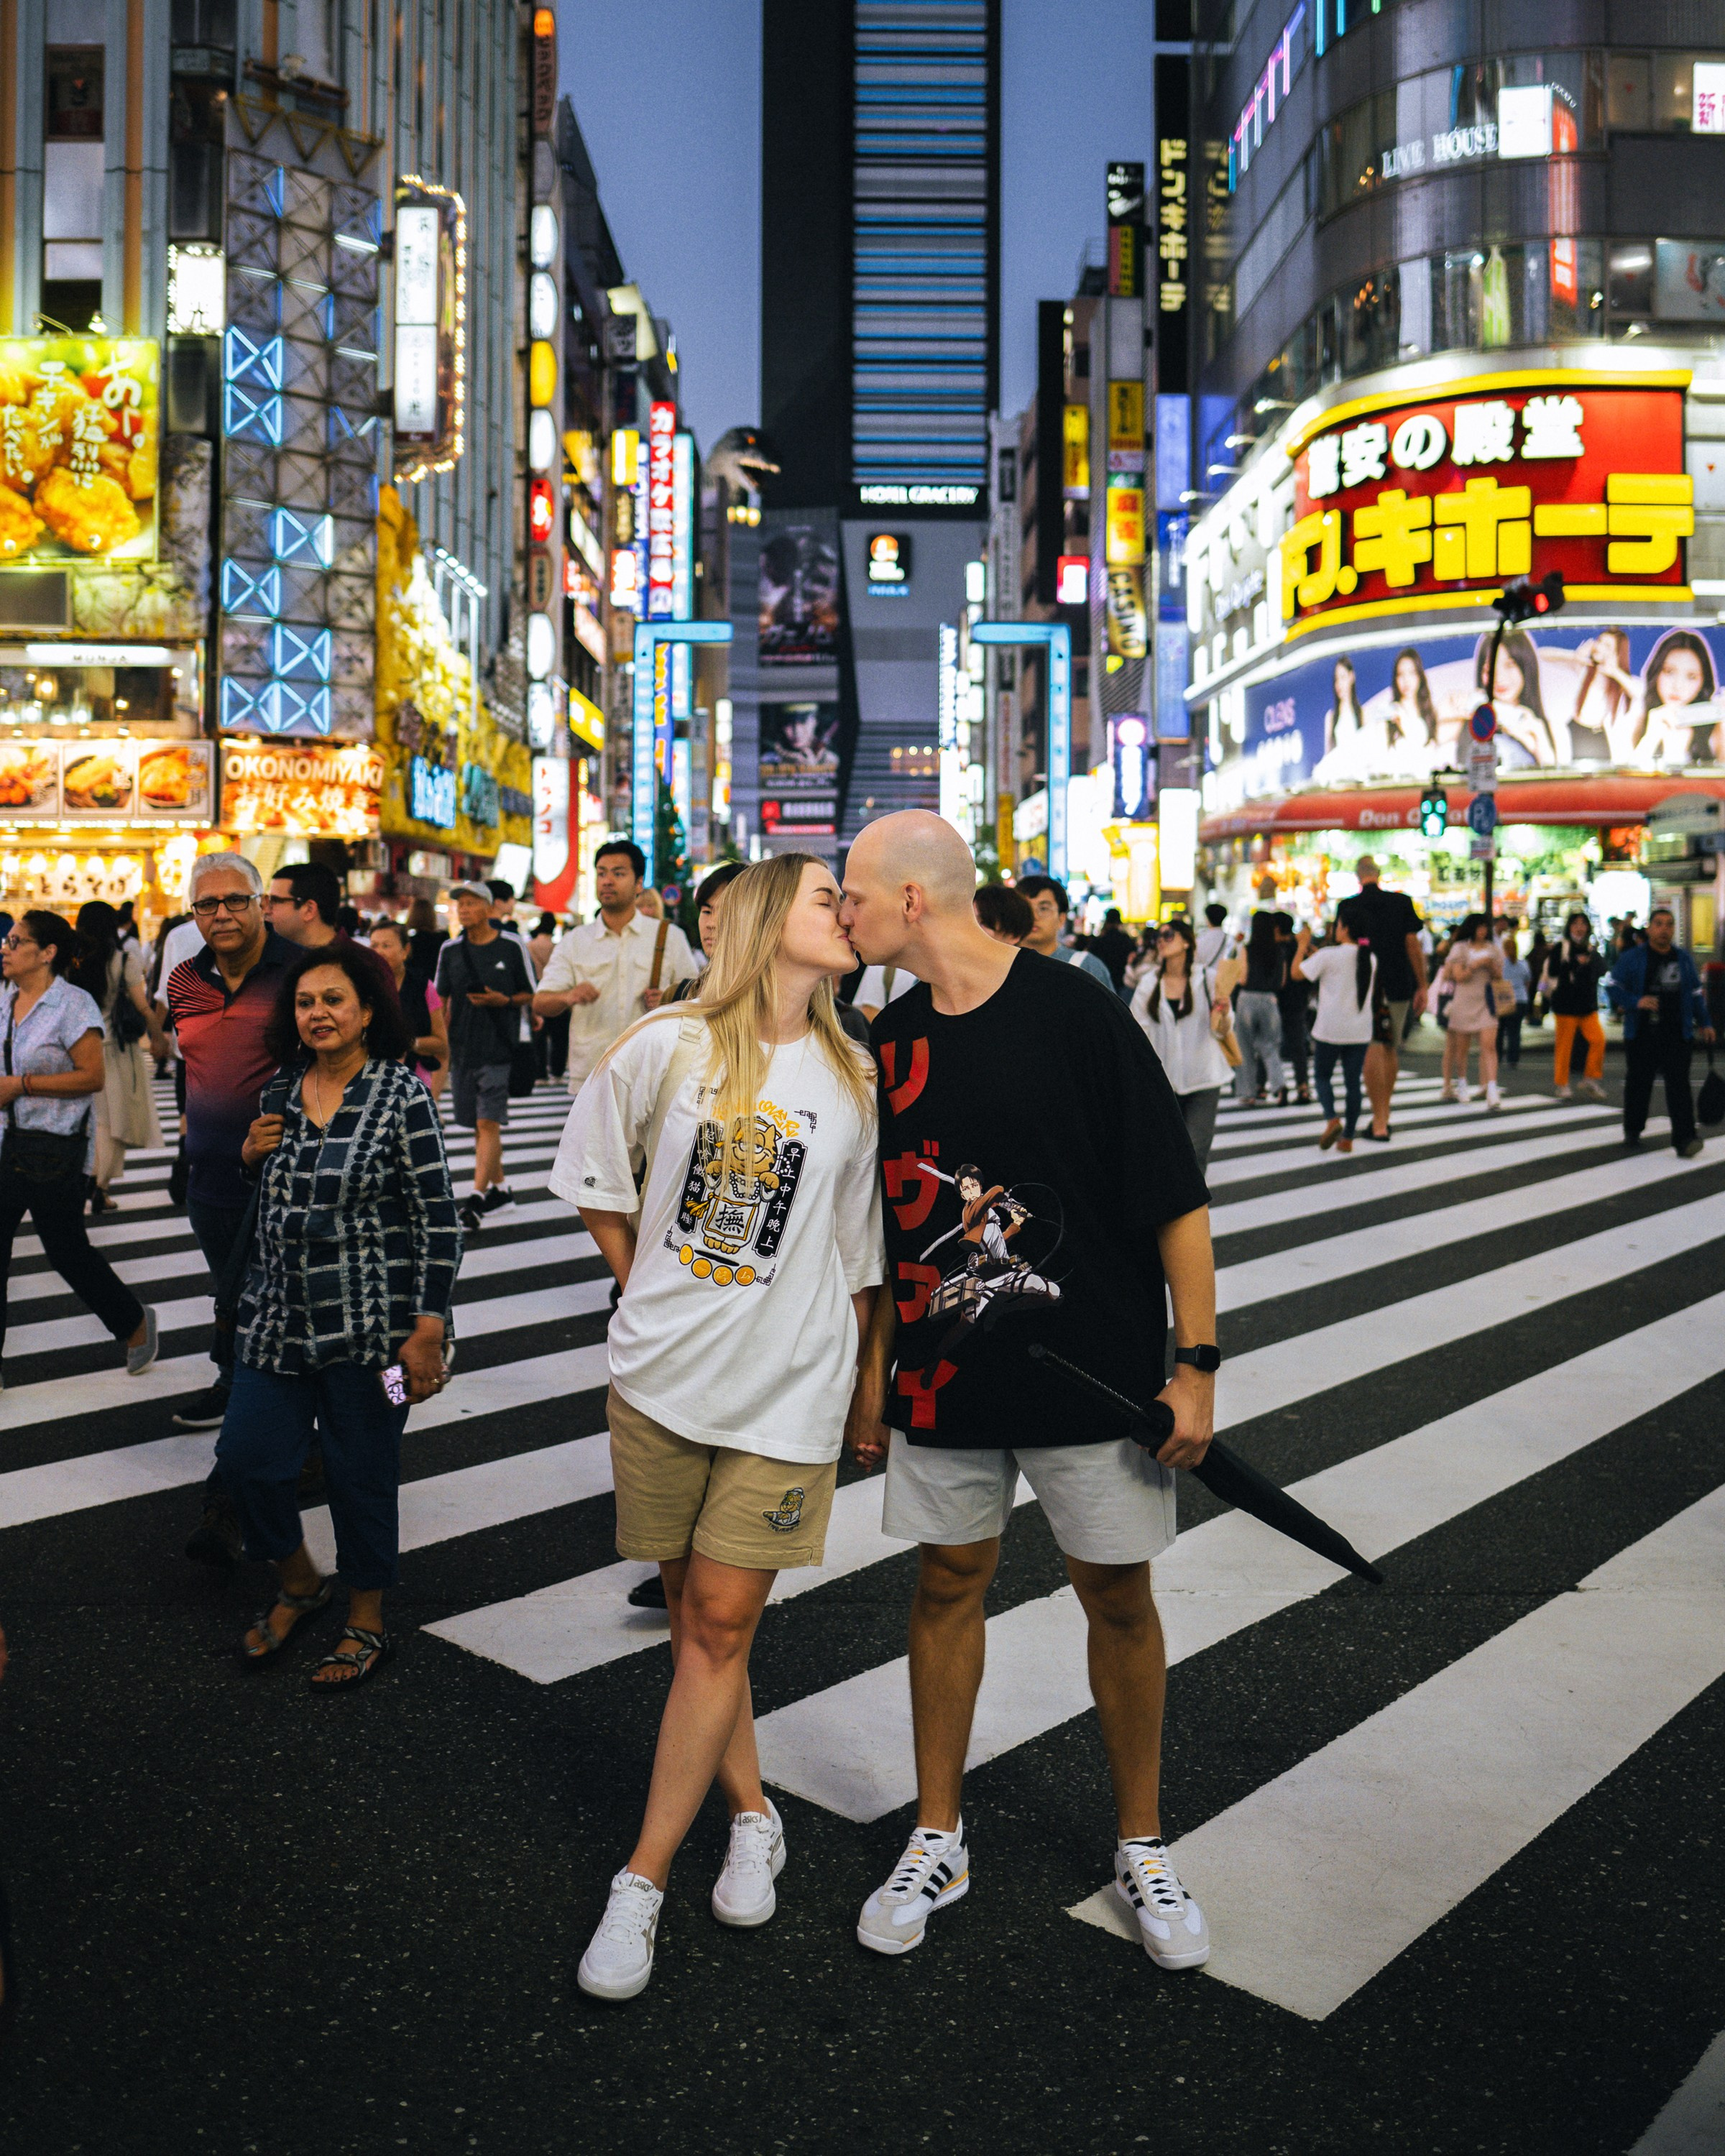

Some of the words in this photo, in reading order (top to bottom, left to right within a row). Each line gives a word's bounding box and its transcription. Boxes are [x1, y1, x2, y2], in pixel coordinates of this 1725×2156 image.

[1381, 139, 1425, 179] LIVE
[1432, 123, 1499, 162] HOUSE
[1307, 395, 1585, 499] 驚安の殿堂
[1109, 571, 1141, 650] CASINO
[224, 755, 384, 789] OKONOMIYAKI
[1359, 808, 1400, 829] Don
[715, 1204, 745, 1235] 撫
[880, 1036, 958, 1430] リヴァイ
[742, 1815, 759, 1824] asics
[634, 1879, 651, 1892] asics
